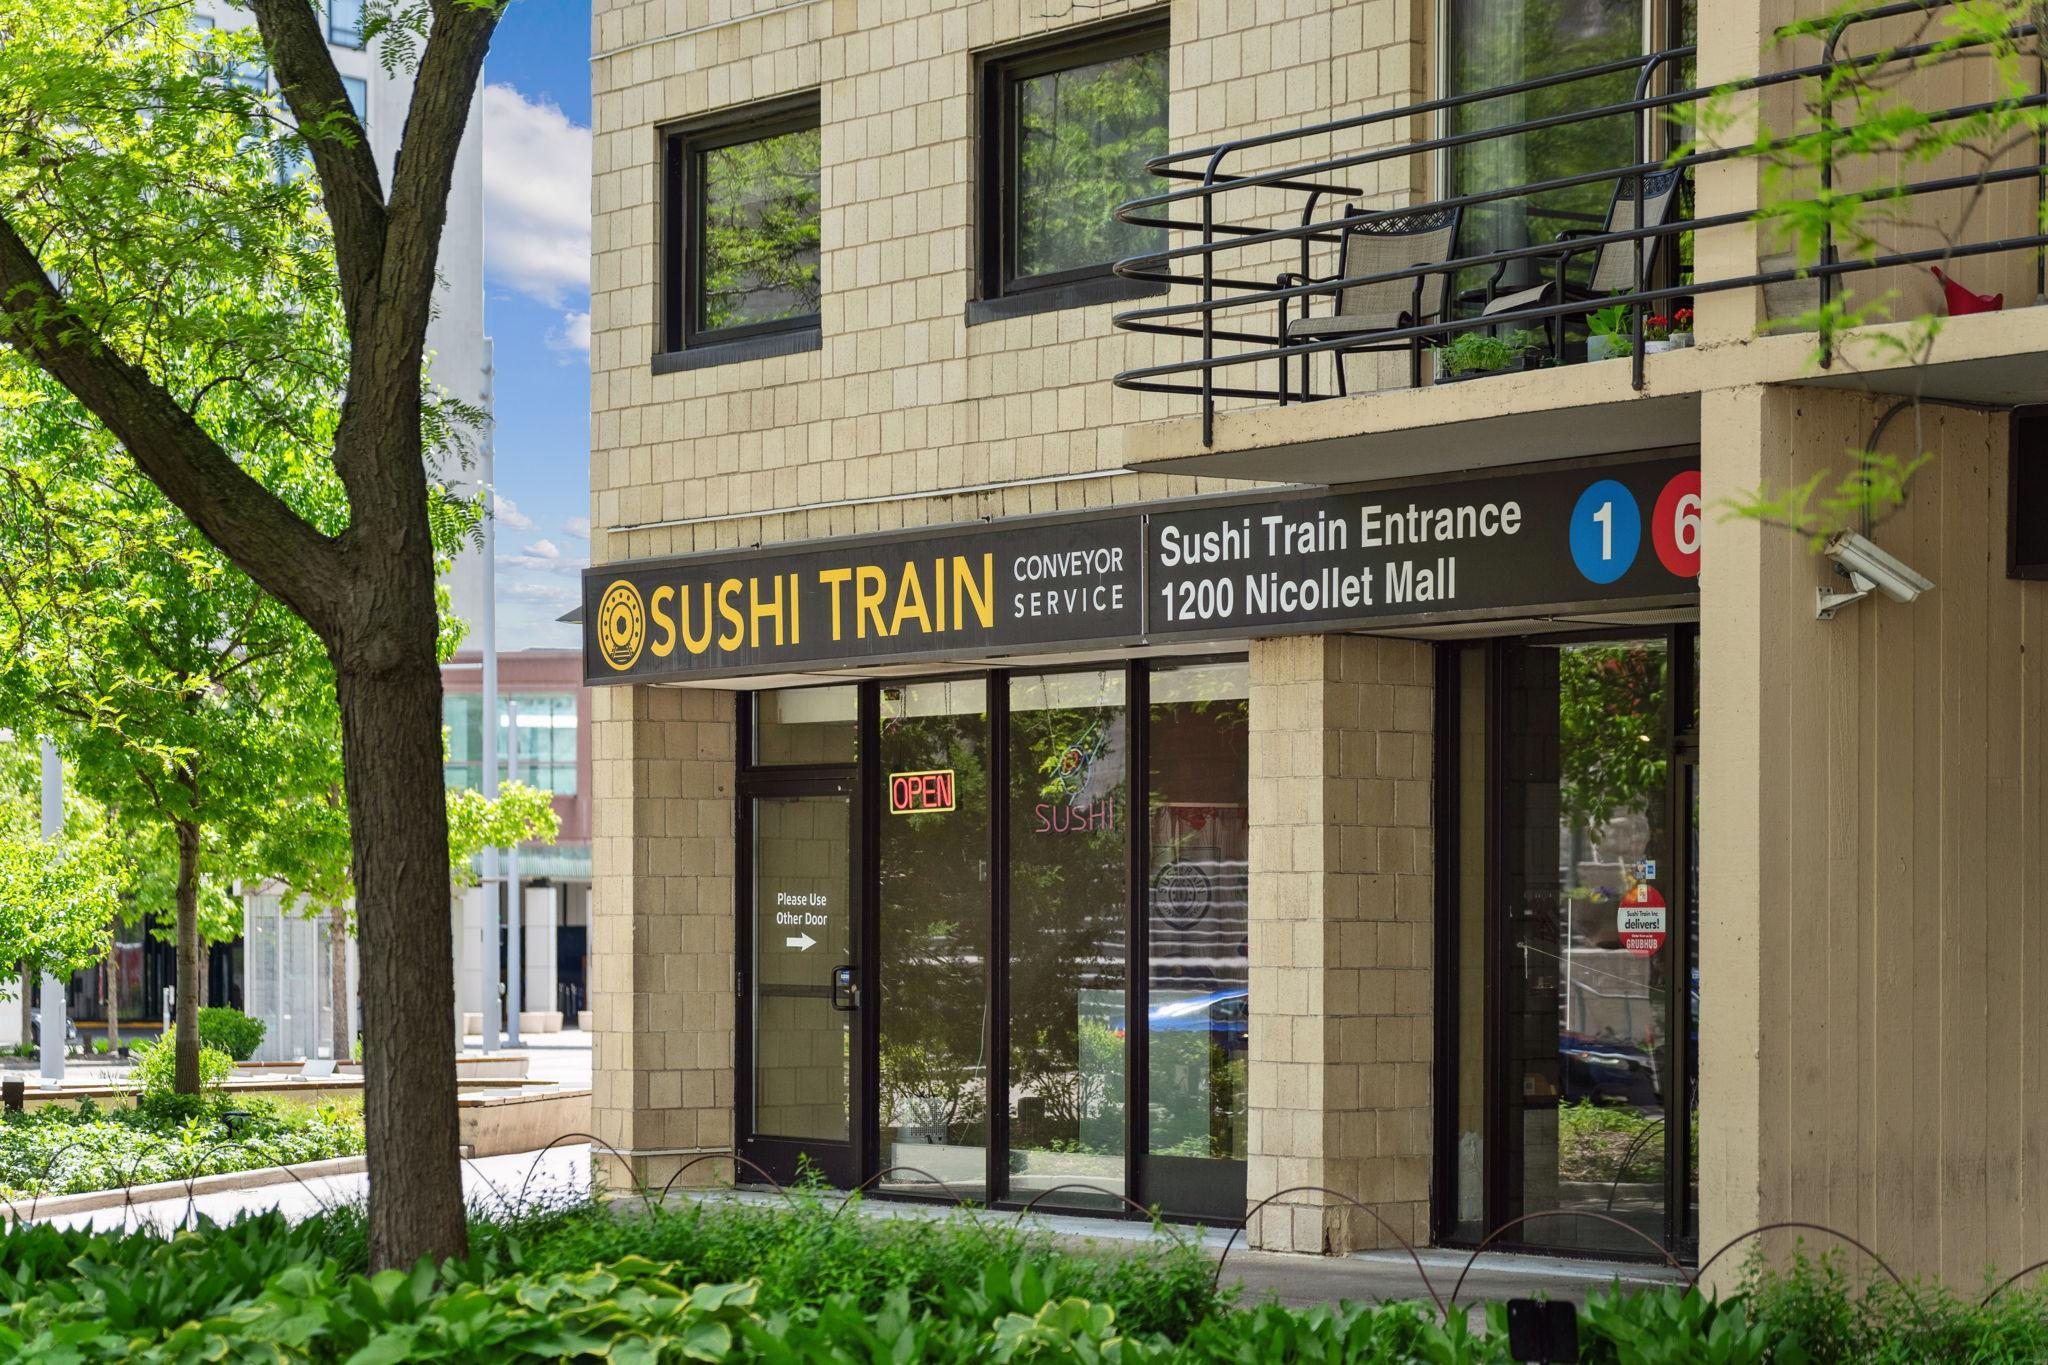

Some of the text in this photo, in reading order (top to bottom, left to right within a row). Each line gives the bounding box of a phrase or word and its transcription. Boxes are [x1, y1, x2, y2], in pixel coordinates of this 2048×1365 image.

[1161, 501, 1522, 566] Sushi Train Entrance
[1593, 493, 1701, 560] 1 6
[1013, 547, 1123, 582] CONVEYOR
[650, 553, 994, 657] SUSHI TRAIN
[1014, 584, 1124, 618] SERVICE
[1162, 556, 1456, 622] 1200 Nicollet Mall
[893, 774, 951, 810] OPEN
[1035, 796, 1115, 833] SUSHI
[777, 892, 827, 906] Please Use
[776, 911, 828, 926] Other Door
[1625, 919, 1660, 930] delivers!
[1626, 939, 1658, 949] GRUBHUB
